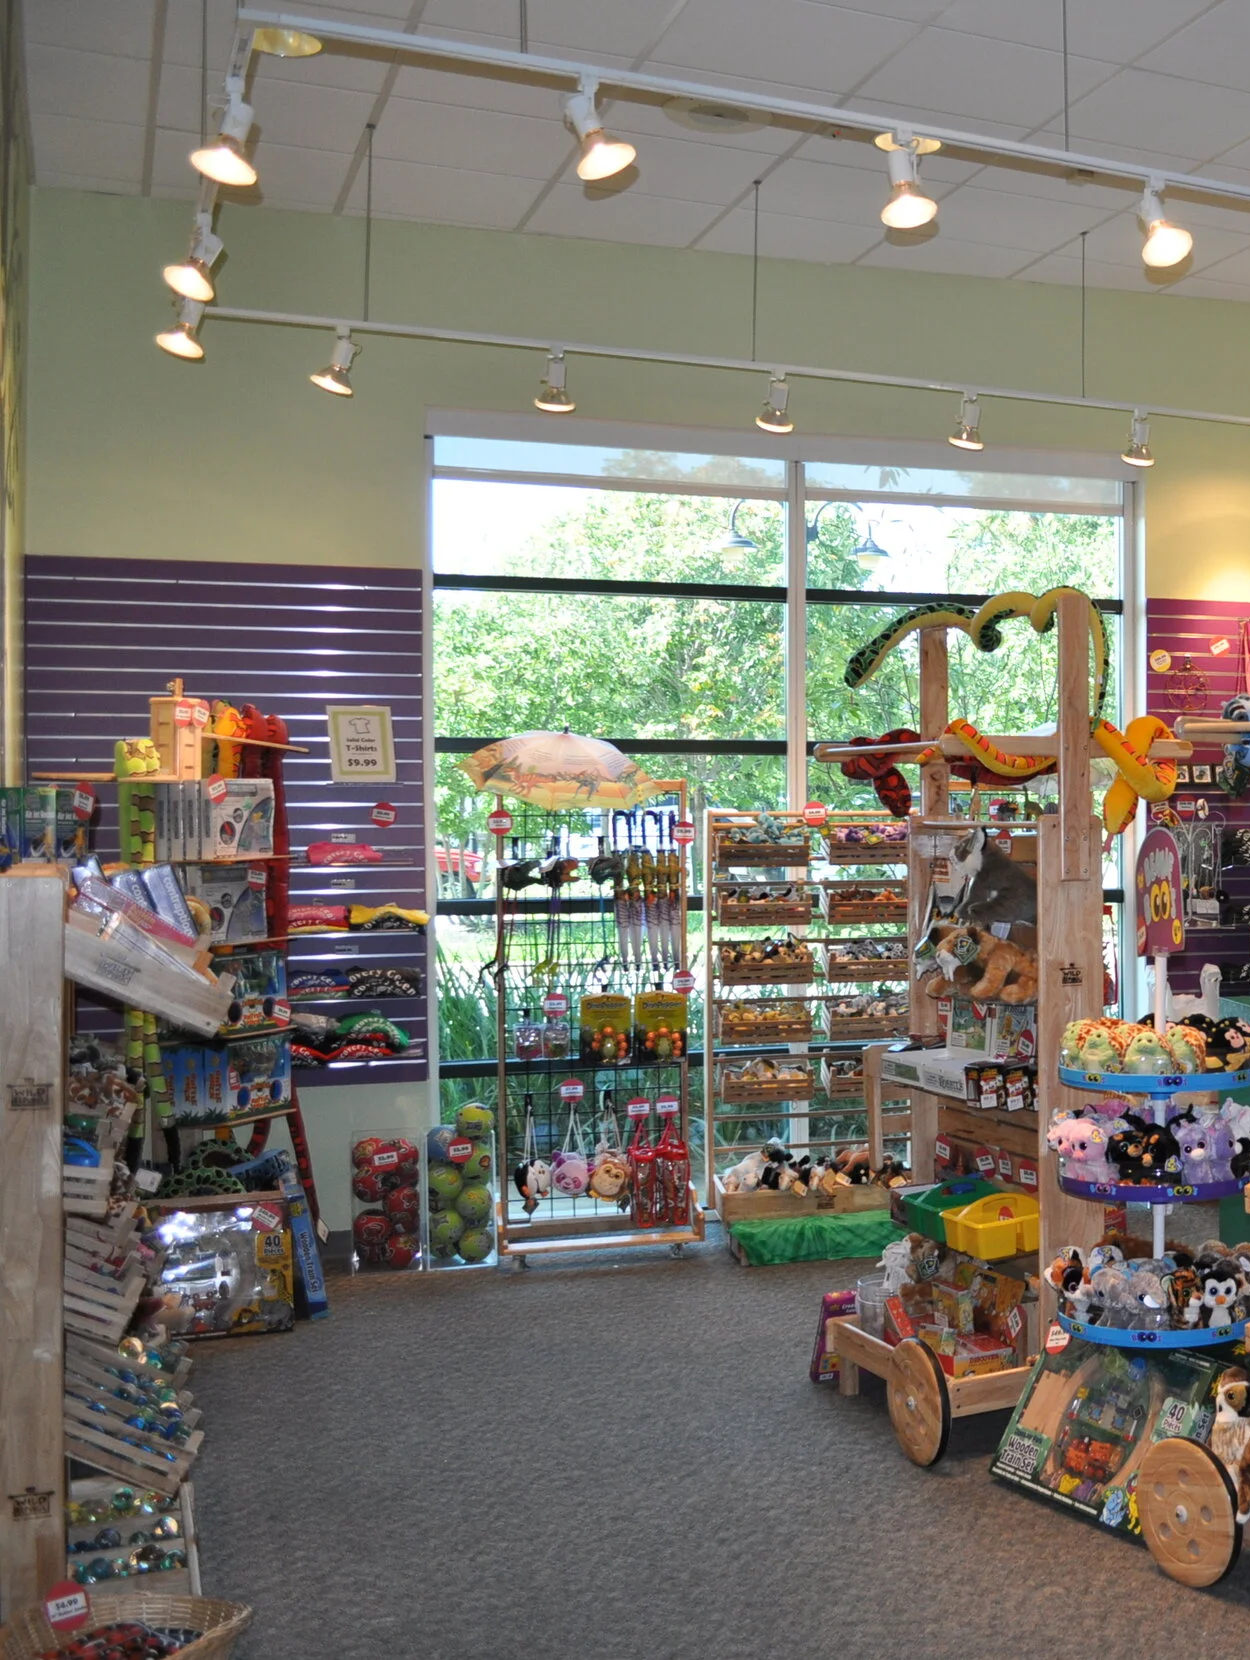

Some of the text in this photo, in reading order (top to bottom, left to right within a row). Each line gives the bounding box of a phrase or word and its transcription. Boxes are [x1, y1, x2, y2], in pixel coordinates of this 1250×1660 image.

[346, 744, 378, 752] T-Shirts
[348, 758, 378, 767] $9.99
[163, 876, 197, 939] contraption
[264, 1235, 281, 1247] 40
[300, 1231, 311, 1261] Wooden
[1169, 1404, 1186, 1421] 40
[1199, 1412, 1211, 1430] Set
[1008, 1434, 1040, 1458] Wooden
[1001, 1448, 1021, 1467] Train
[1020, 1455, 1035, 1473] Set
